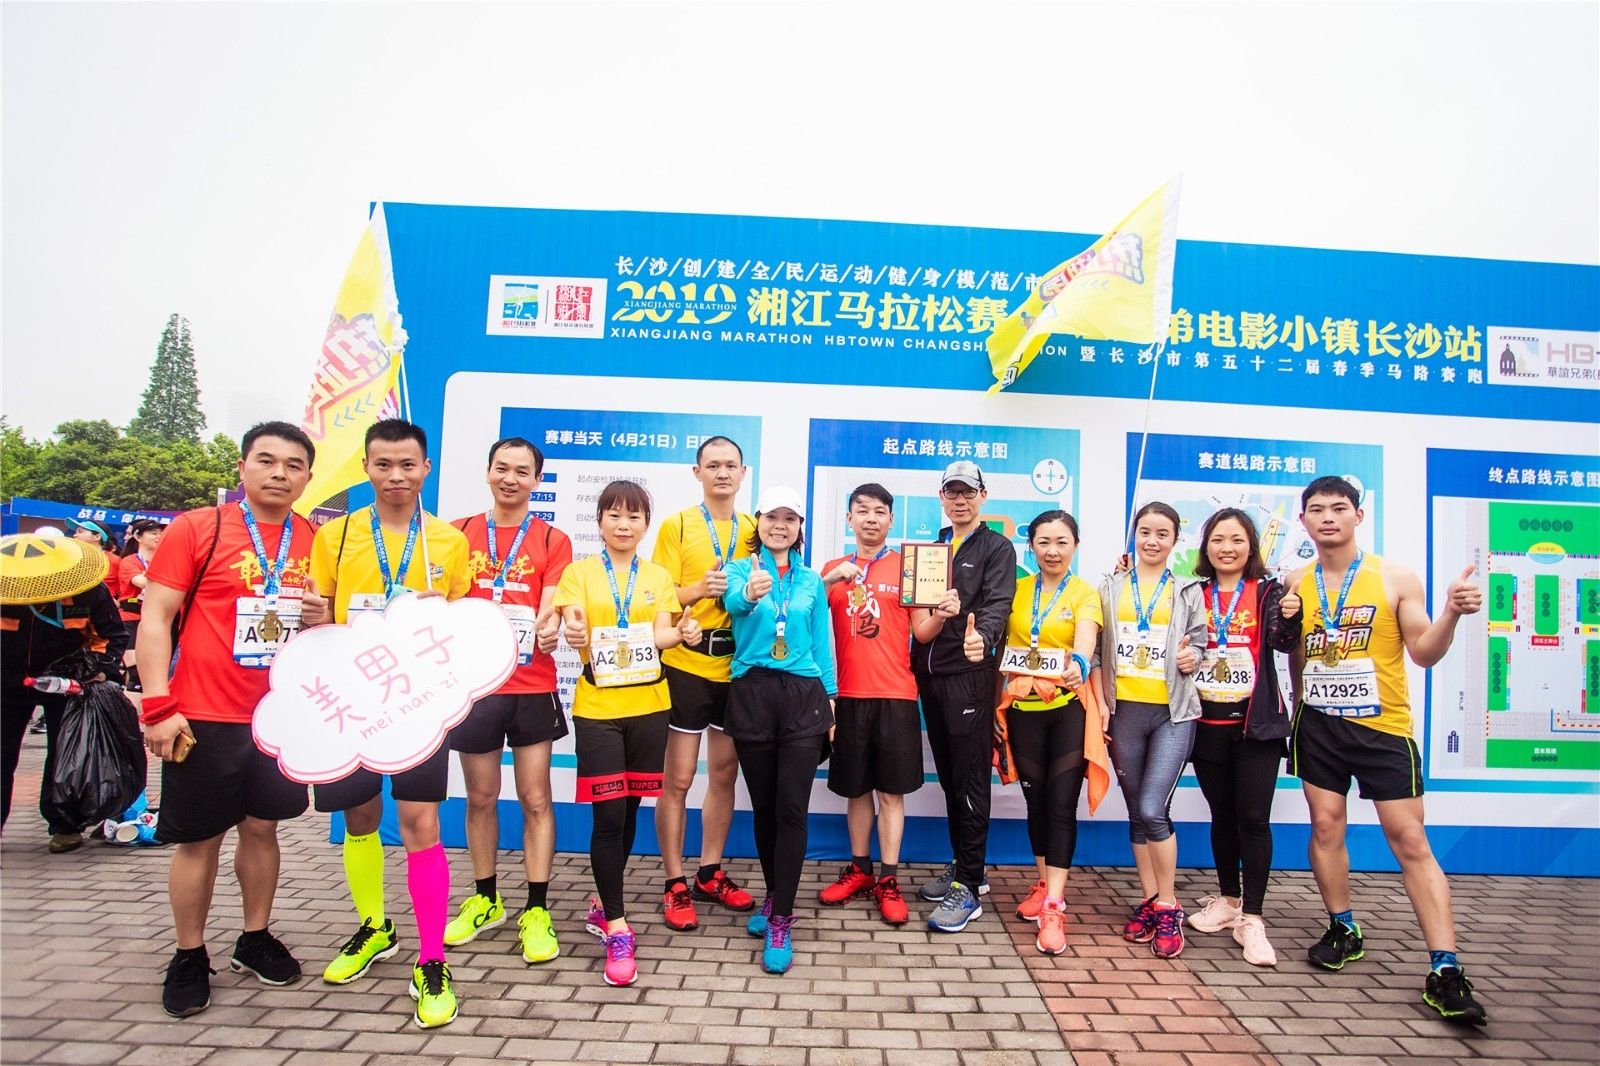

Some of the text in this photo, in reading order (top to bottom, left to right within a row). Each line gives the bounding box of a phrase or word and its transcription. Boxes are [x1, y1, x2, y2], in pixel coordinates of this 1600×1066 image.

[611, 280, 737, 325] 2019
[746, 287, 1008, 334] 湘江马拉松赛
[624, 299, 738, 312] XIANGJIANG MARATHON
[610, 327, 713, 341] XIANGJIANG
[720, 332, 813, 345] MARATHON
[824, 335, 895, 348] HBTOWN
[903, 338, 990, 352] CHANGSH
[882, 437, 1009, 460] 起点路线示意图
[1198, 451, 1317, 474] 赛道线路示意图
[1488, 466, 1600, 488] 终点路线示意图
[1117, 643, 1167, 660] A2754
[300, 626, 455, 733] 美男子
[1195, 670, 1248, 684] A2038
[1309, 683, 1369, 698] A12925
[360, 671, 459, 739] mei nan zi
